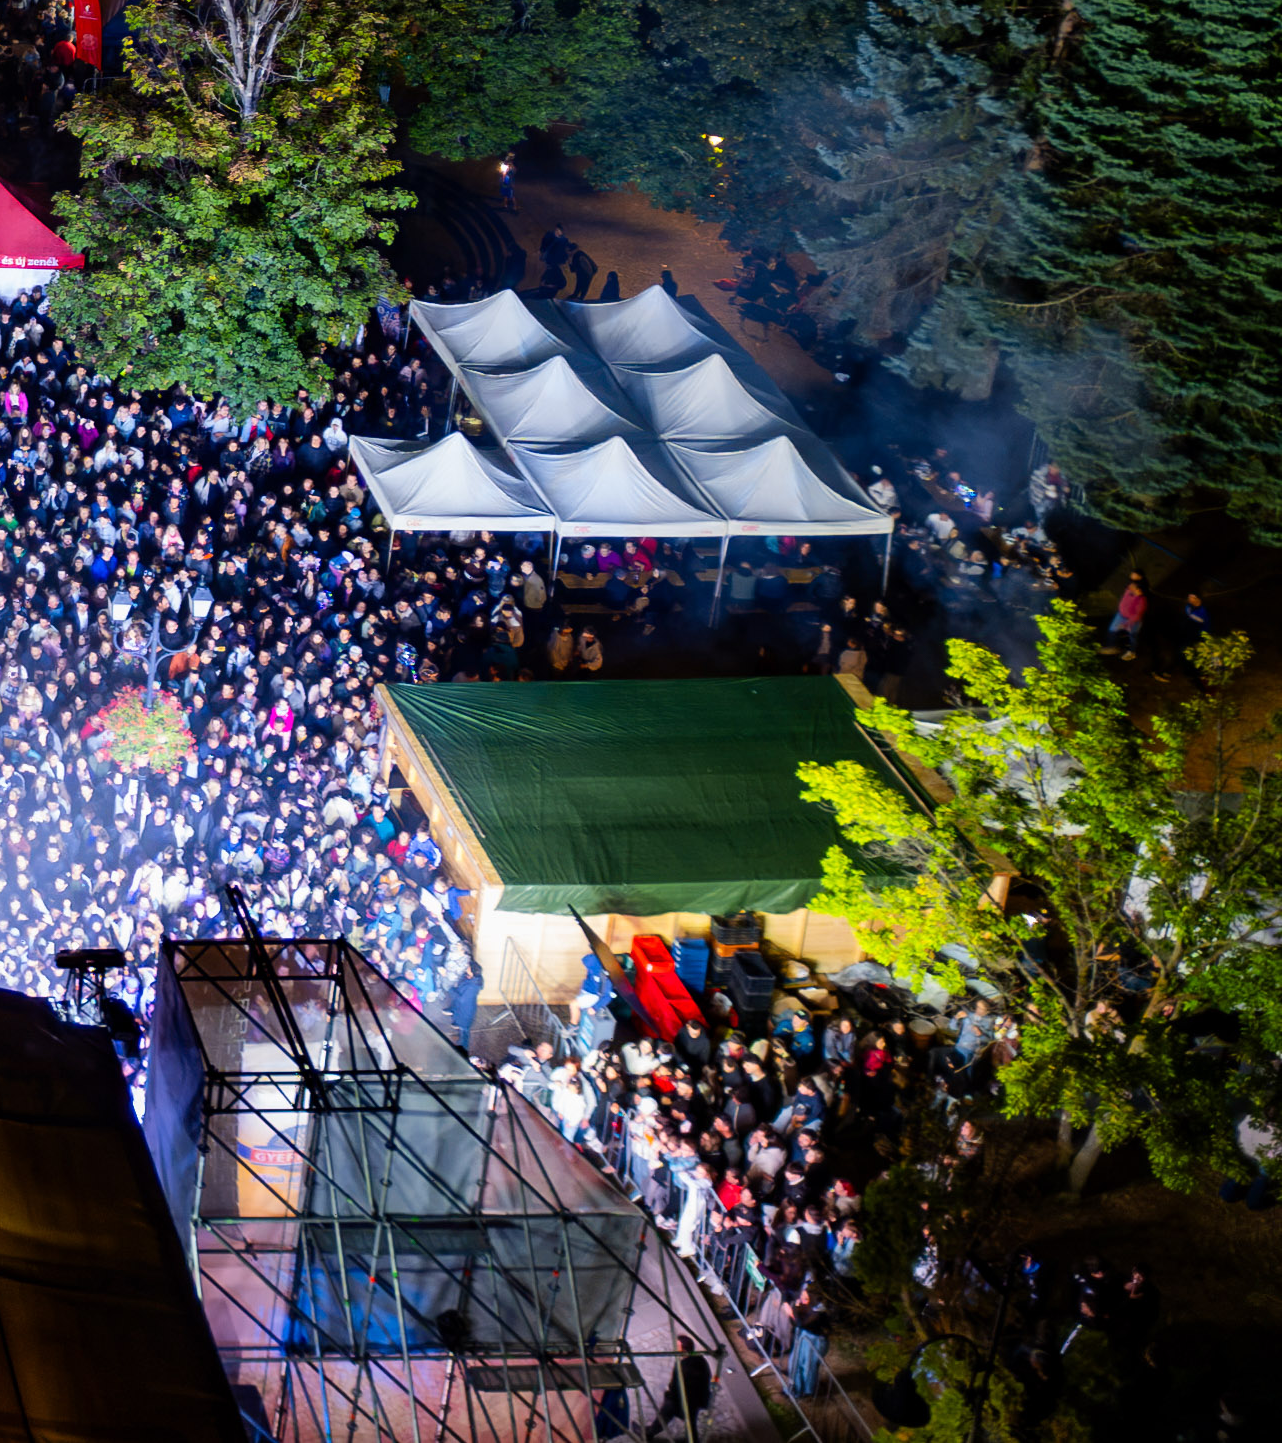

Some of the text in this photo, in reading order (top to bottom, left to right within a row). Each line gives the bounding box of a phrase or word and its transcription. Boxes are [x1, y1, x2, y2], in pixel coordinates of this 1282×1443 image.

[2, 255, 14, 265] és
[16, 256, 27, 268] új
[27, 256, 59, 267] zenék
